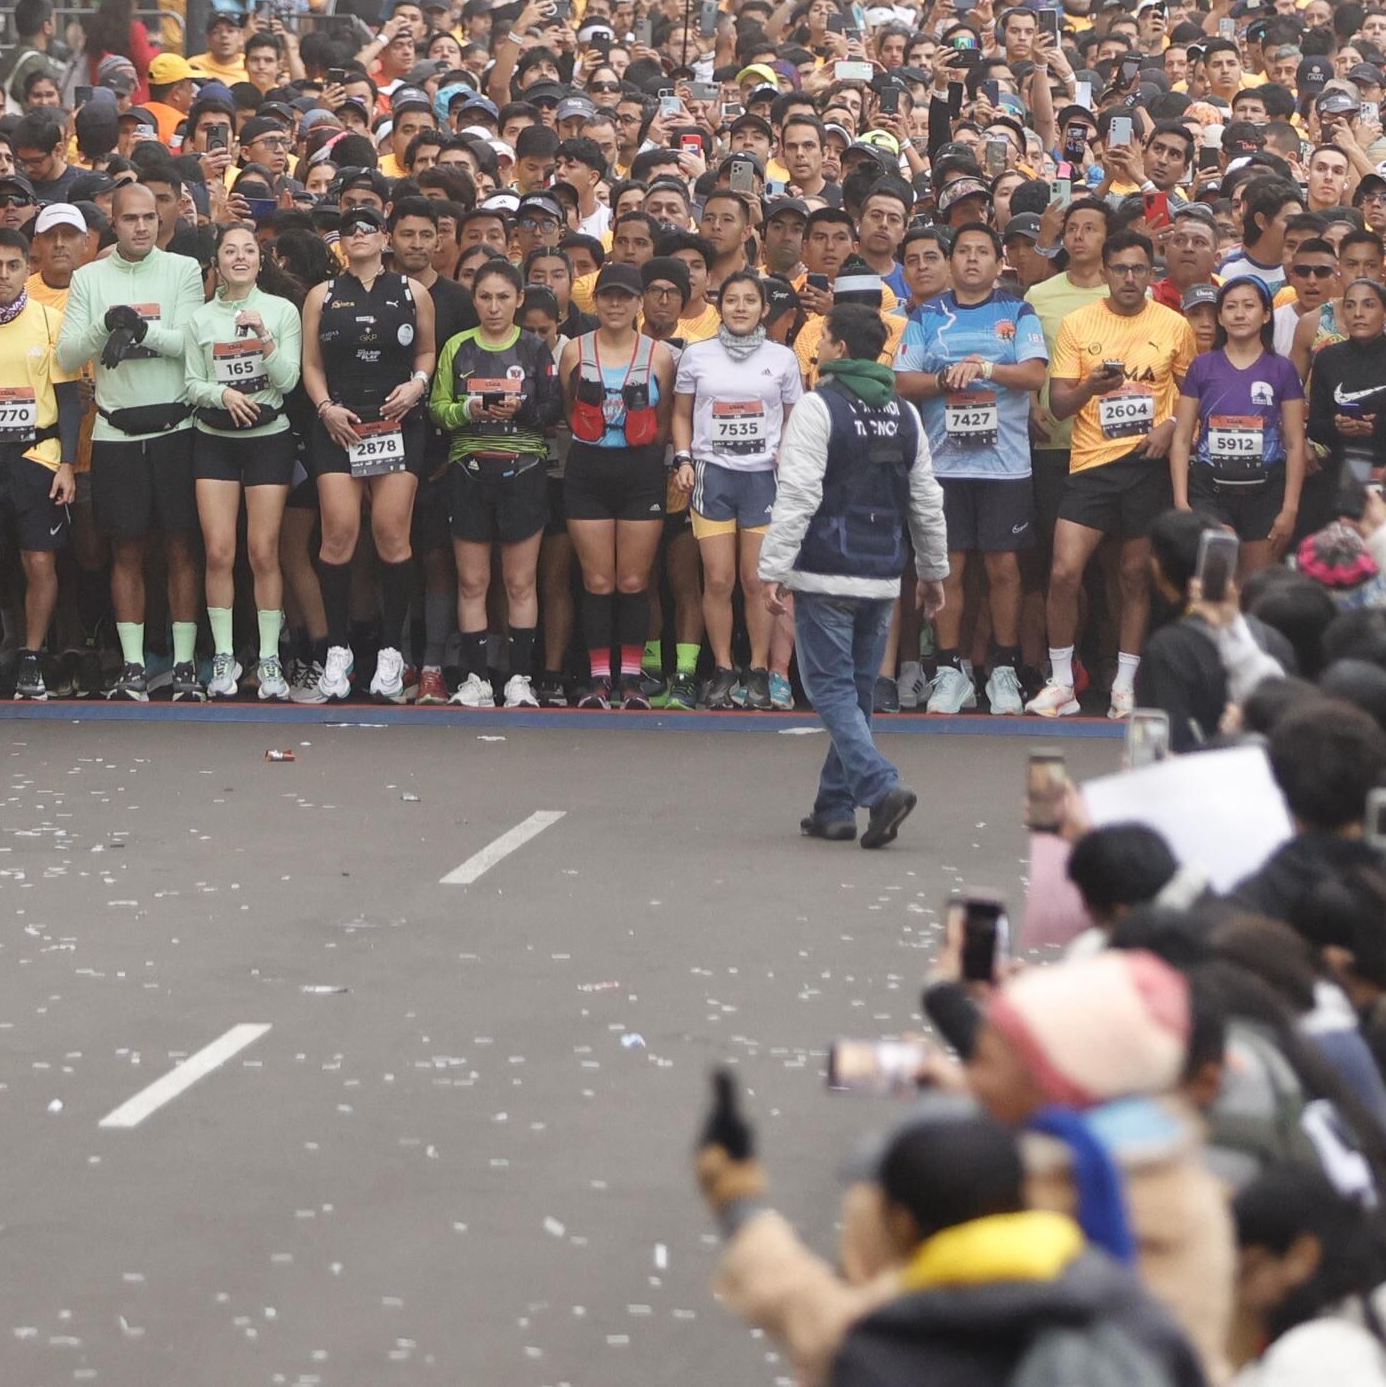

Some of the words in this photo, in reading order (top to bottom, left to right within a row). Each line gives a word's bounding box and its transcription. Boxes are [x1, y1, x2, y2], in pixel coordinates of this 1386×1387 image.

[226, 361, 254, 375] 165
[1106, 403, 1147, 419] 2604
[952, 412, 990, 426] 7427
[719, 422, 758, 436] 7535
[357, 439, 396, 456] 2878
[1217, 438, 1254, 451] 5912
